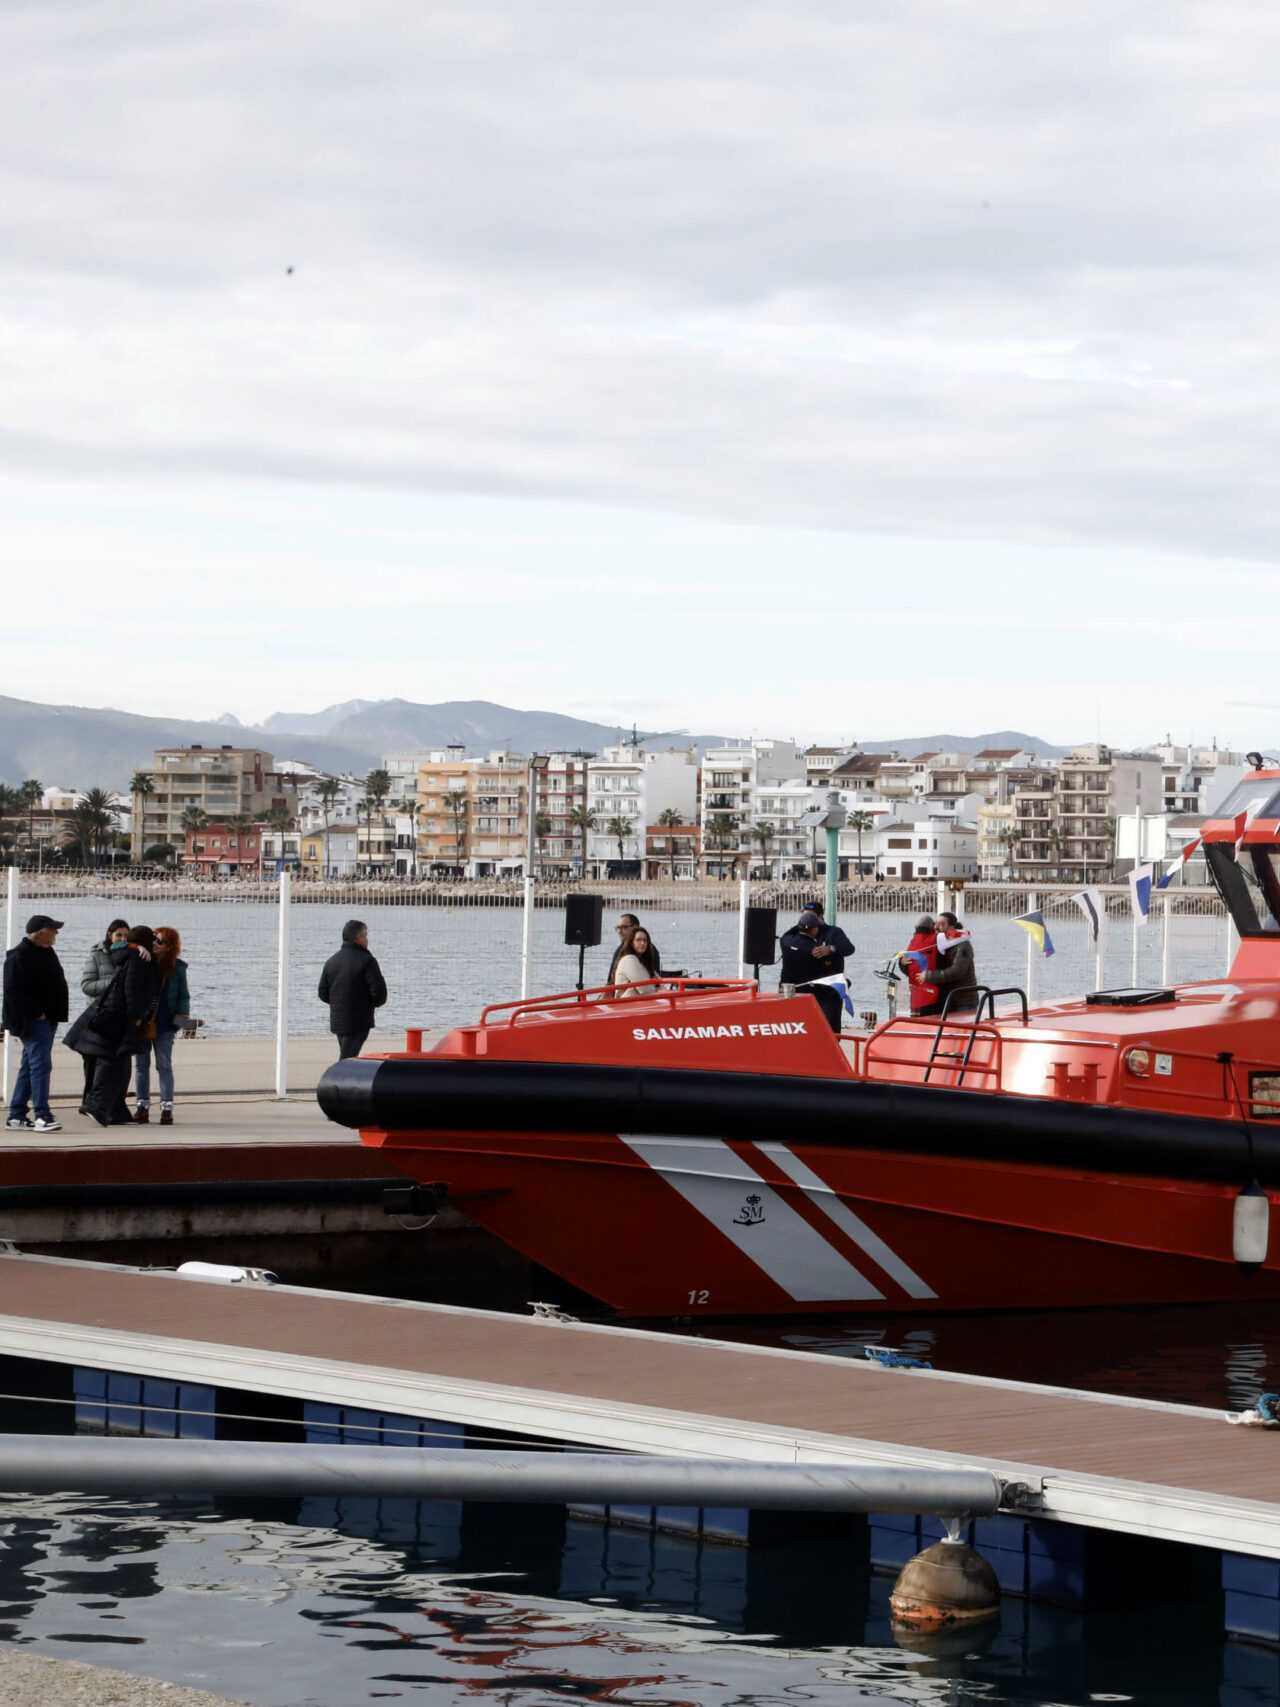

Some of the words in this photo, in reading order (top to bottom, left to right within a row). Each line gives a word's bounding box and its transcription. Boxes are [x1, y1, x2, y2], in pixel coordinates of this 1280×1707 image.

[632, 1024, 744, 1041] SALVAMAR
[748, 1021, 808, 1037] FENIX
[688, 1290, 710, 1305] 12
